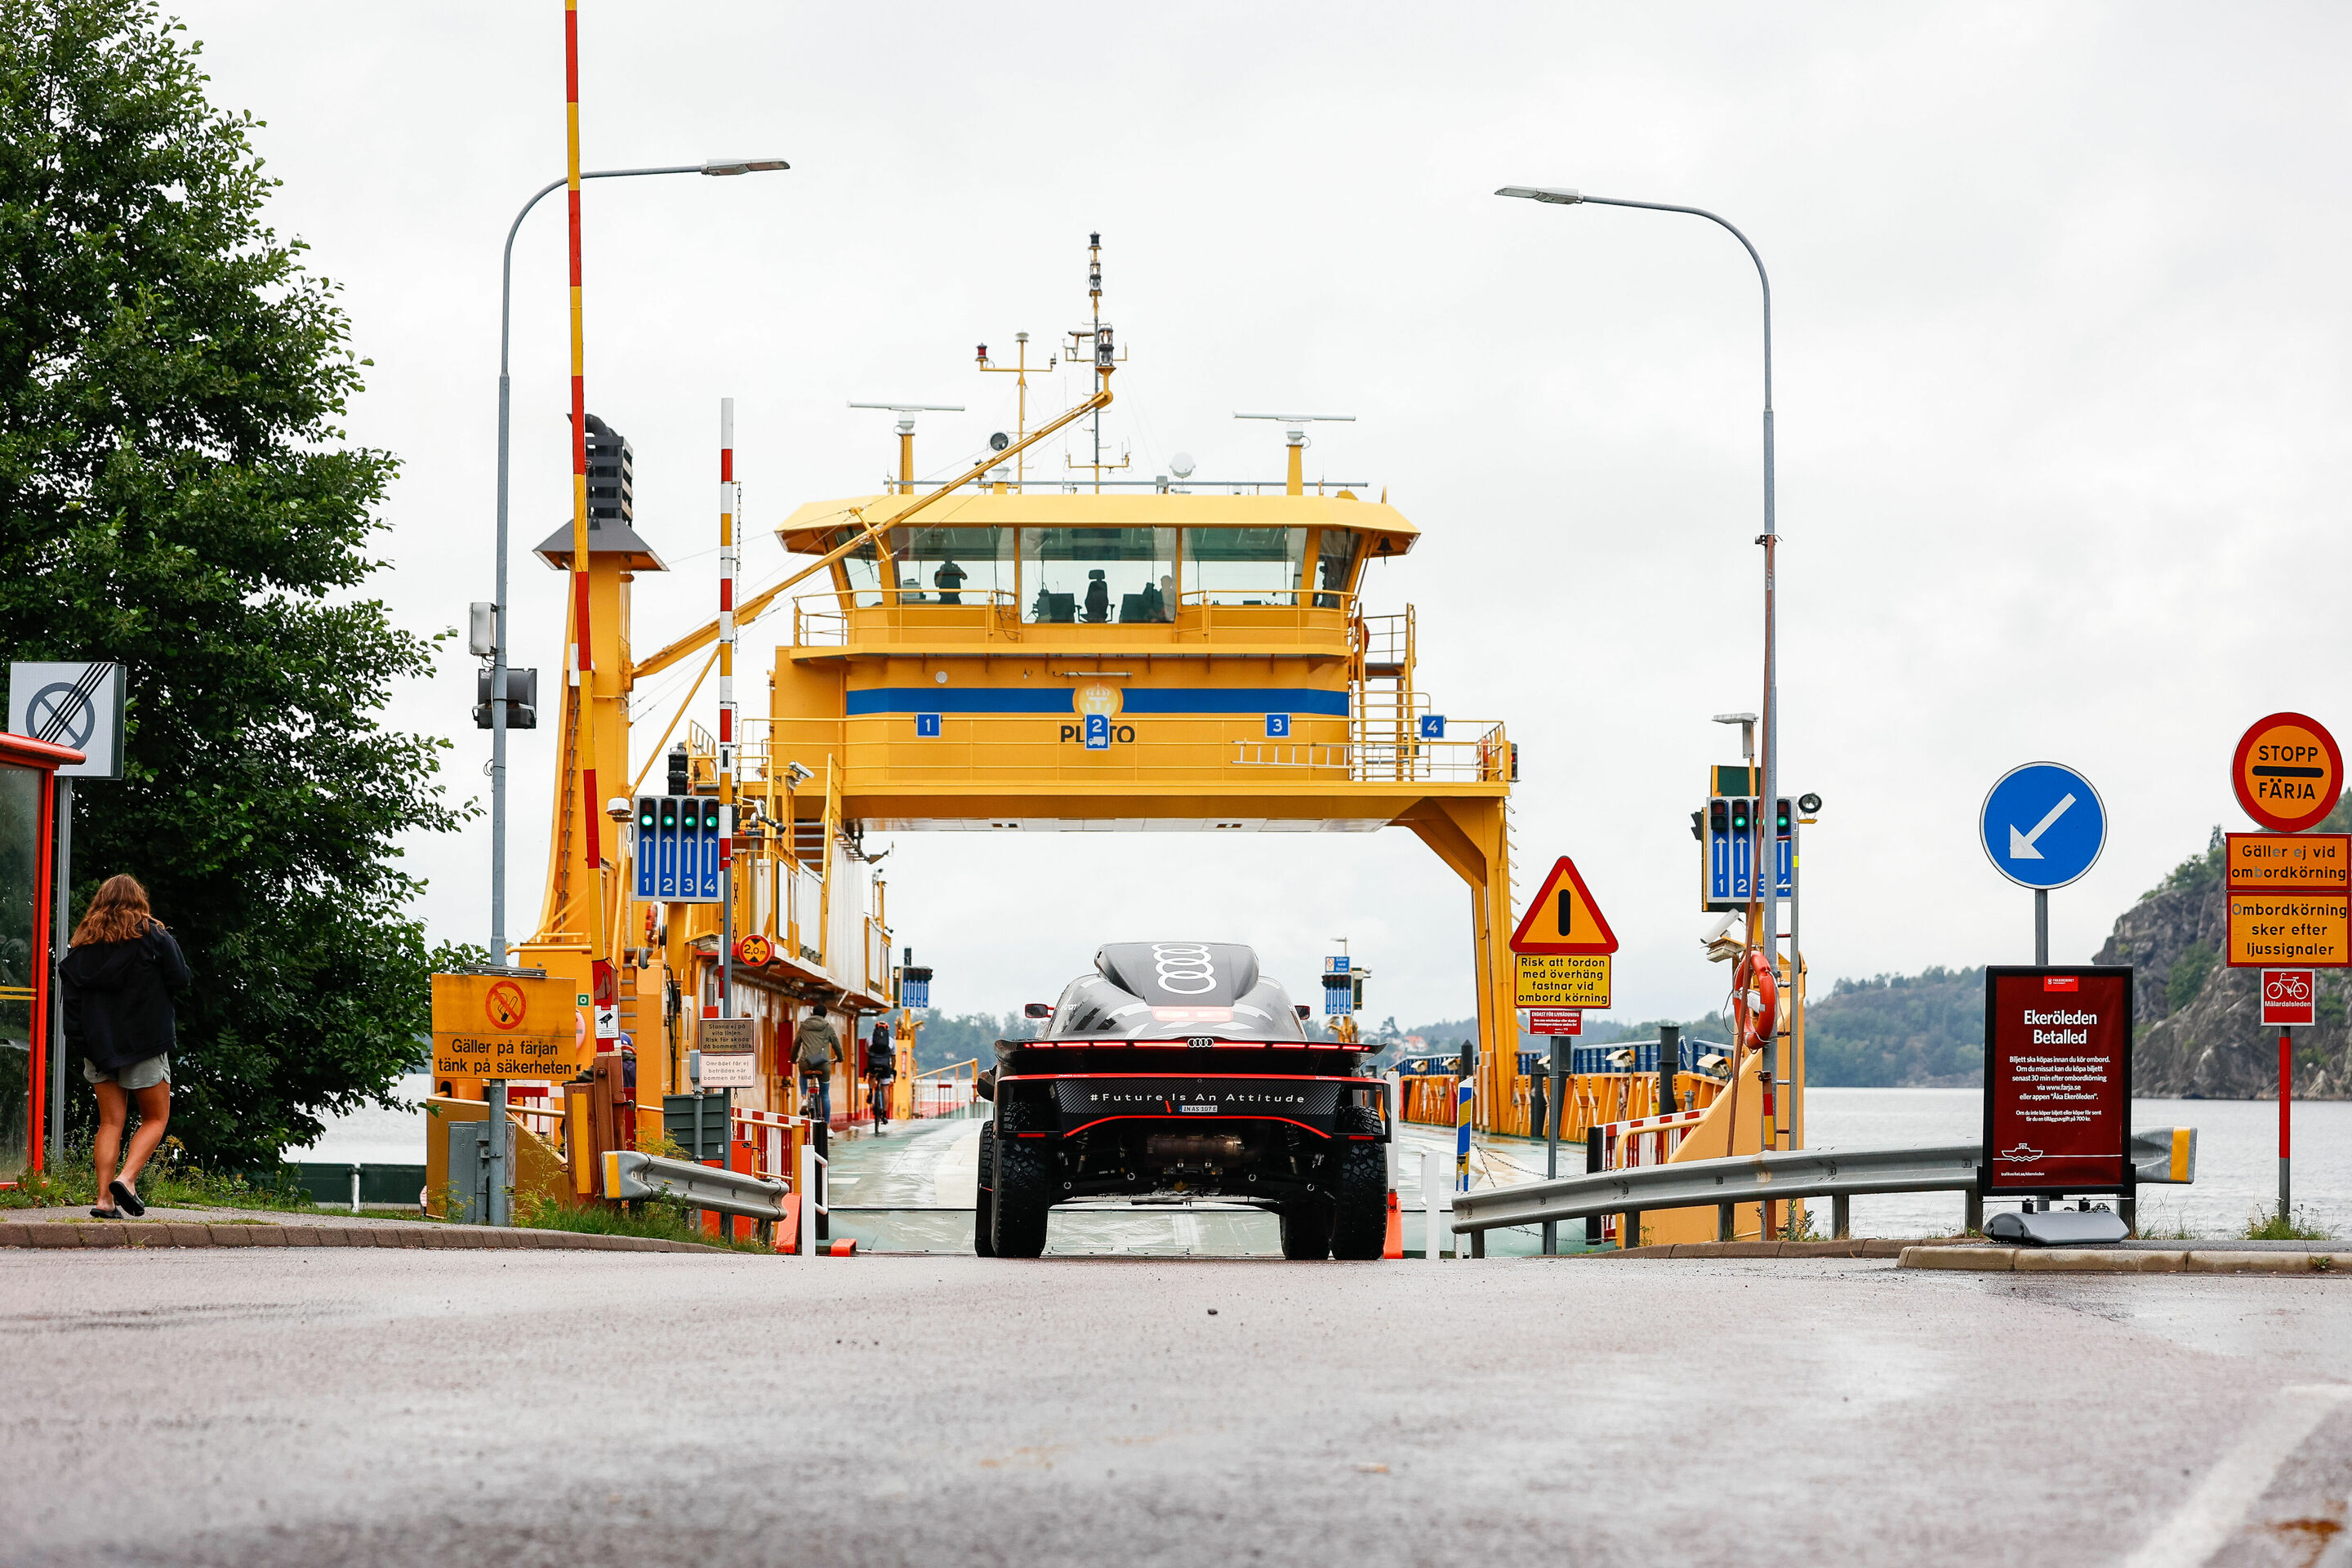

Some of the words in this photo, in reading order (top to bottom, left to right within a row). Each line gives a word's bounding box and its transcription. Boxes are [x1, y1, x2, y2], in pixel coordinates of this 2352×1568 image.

[926, 719, 930, 732] 1
[1092, 719, 1102, 733] 2
[1273, 719, 1283, 733] 3
[1428, 720, 1438, 733] 4
[1061, 725, 1135, 743] PLTO
[2258, 746, 2319, 762] STOPP
[2259, 778, 2316, 800] FÄRJA
[2243, 845, 2287, 857] Gäller
[2294, 846, 2306, 860] ej
[2313, 846, 2335, 858] vid
[2232, 866, 2346, 881] ombordkörning
[644, 878, 649, 891] 1
[663, 878, 673, 892] 2
[684, 878, 694, 892] 3
[704, 879, 715, 892] 4
[1718, 879, 1724, 892] 1
[1737, 879, 1748, 892] 2
[2232, 903, 2347, 919] Ombordkörning
[2252, 924, 2285, 935] sker
[2292, 924, 2328, 935] efter
[2247, 942, 2334, 957] ljussignaler
[1521, 957, 1544, 966] Risk
[1549, 959, 1564, 967] att
[1568, 958, 1605, 967] fordon
[1523, 969, 1546, 978] med
[1550, 969, 1603, 981] överhäng
[1532, 981, 1573, 990] fastnar
[1577, 982, 1593, 990] vid
[1518, 993, 1561, 1002] ombord
[1565, 993, 1607, 1004] körning
[2024, 1009, 2097, 1025] Ekeröleden
[2034, 1029, 2087, 1044] Betalled
[452, 1039, 491, 1054] Gäller
[497, 1040, 514, 1056] på
[520, 1040, 558, 1058] färjan
[439, 1058, 468, 1071] tänk
[474, 1058, 491, 1075] på
[497, 1059, 572, 1074] säkerheten
[2073, 1065, 2086, 1073] köpa
[2087, 1065, 2103, 1073] biljett
[1226, 1094, 1304, 1102] Attitude
